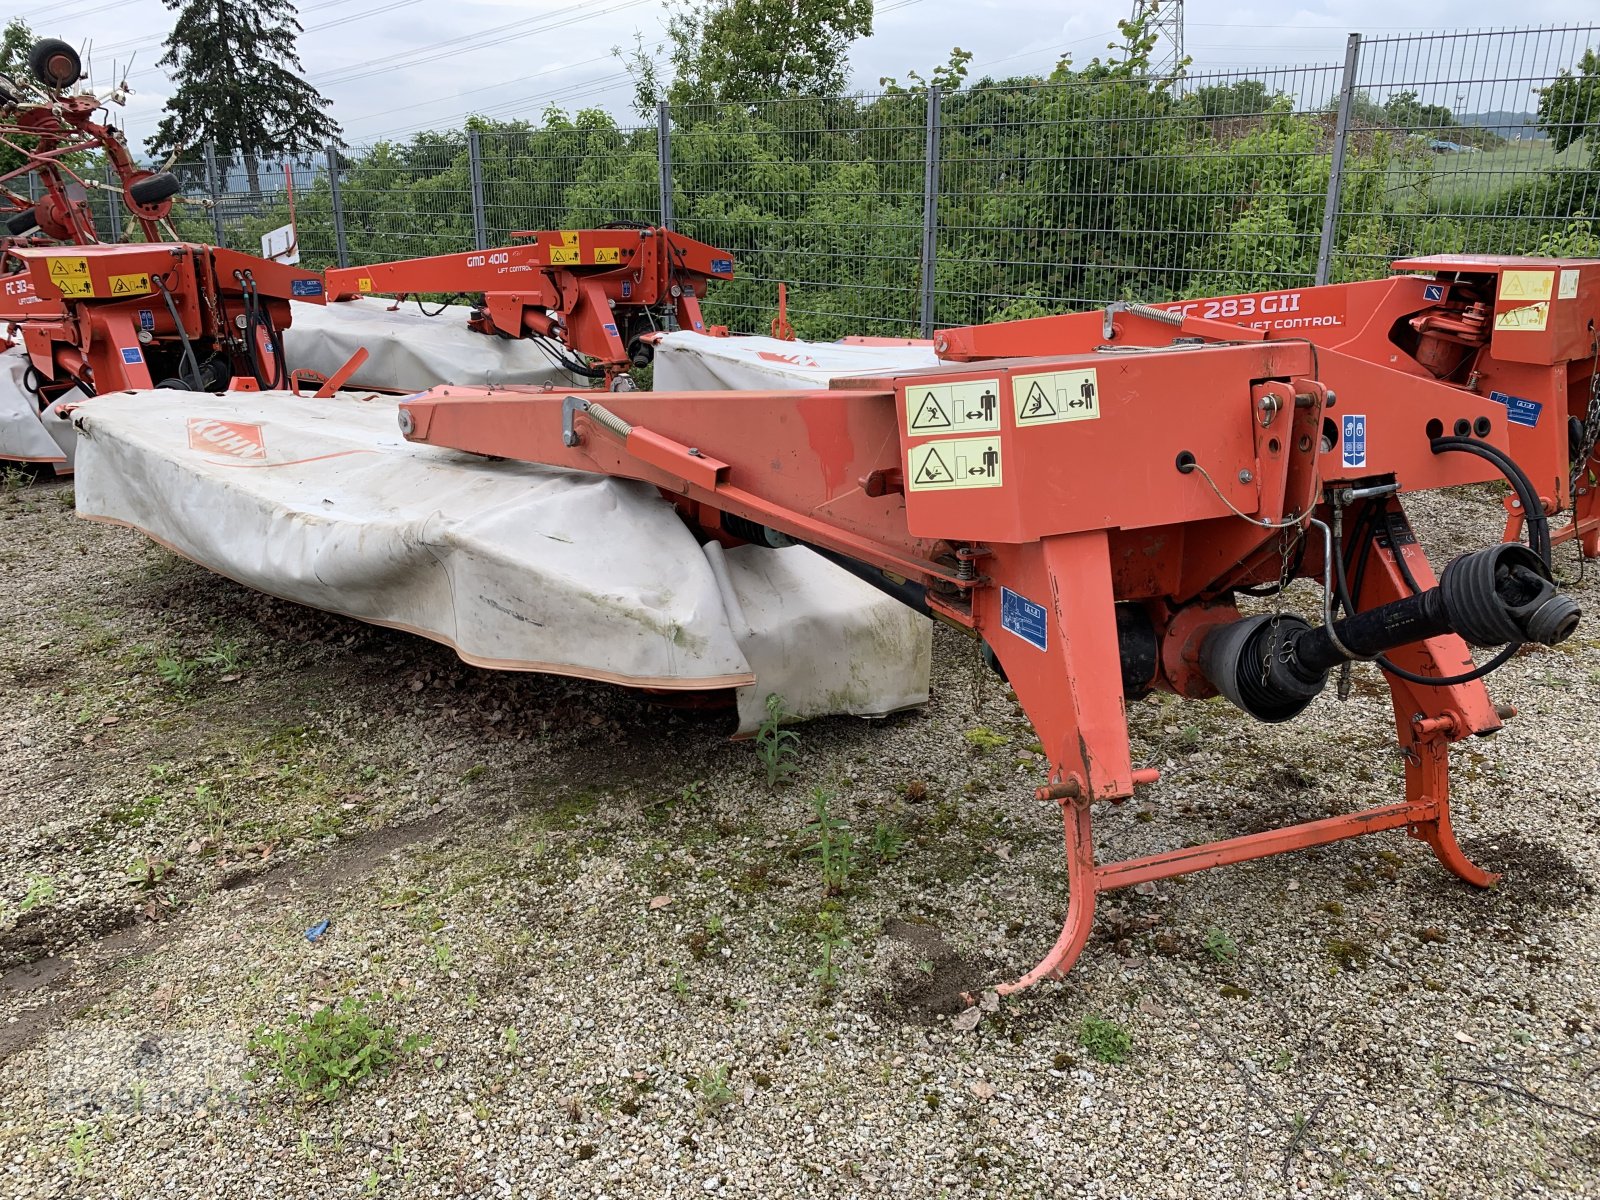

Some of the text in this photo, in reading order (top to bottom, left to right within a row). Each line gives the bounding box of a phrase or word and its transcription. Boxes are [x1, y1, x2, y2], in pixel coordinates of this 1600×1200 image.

[467, 255, 485, 267] GMD
[488, 252, 509, 264] 4010
[1203, 298, 1256, 319] 283
[1260, 293, 1301, 314] GII
[1250, 315, 1342, 330] IFT CONTROL
[185, 419, 266, 458] KUHN
